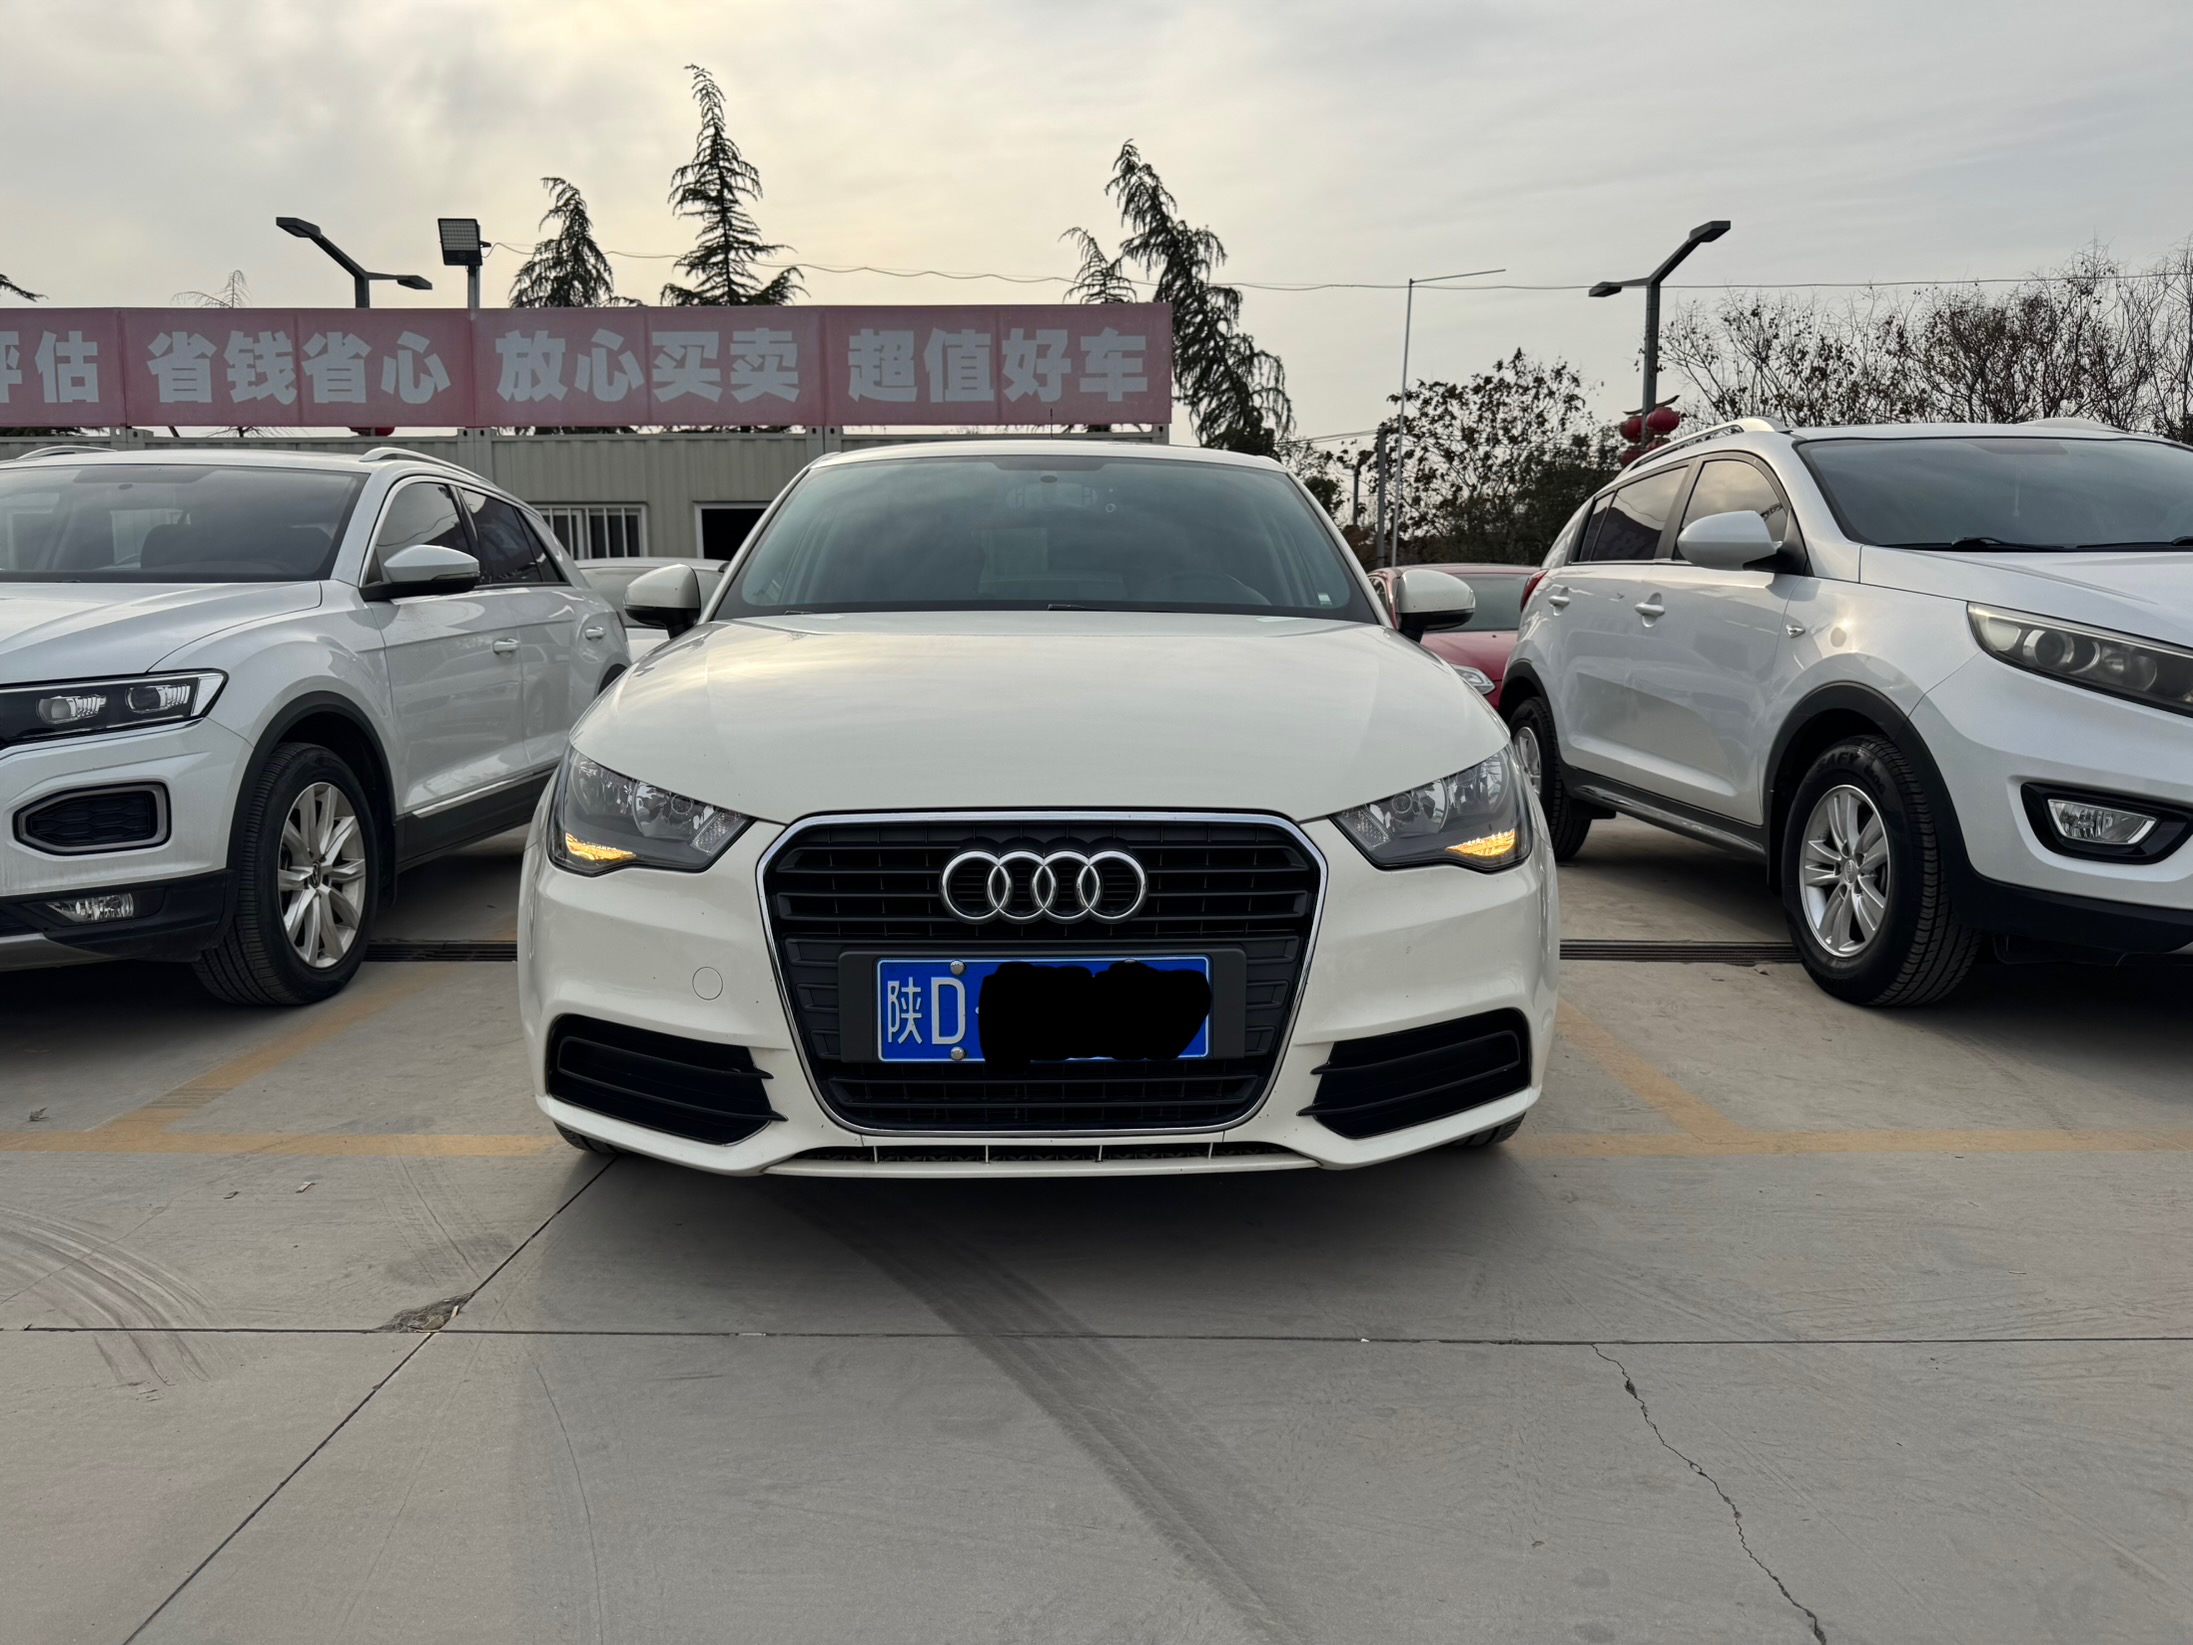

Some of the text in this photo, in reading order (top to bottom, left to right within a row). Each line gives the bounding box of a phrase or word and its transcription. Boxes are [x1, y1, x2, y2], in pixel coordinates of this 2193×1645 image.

[147, 330, 452, 405] 省钱省心
[495, 327, 799, 402] 放心买卖
[847, 327, 1149, 402] 超值好车
